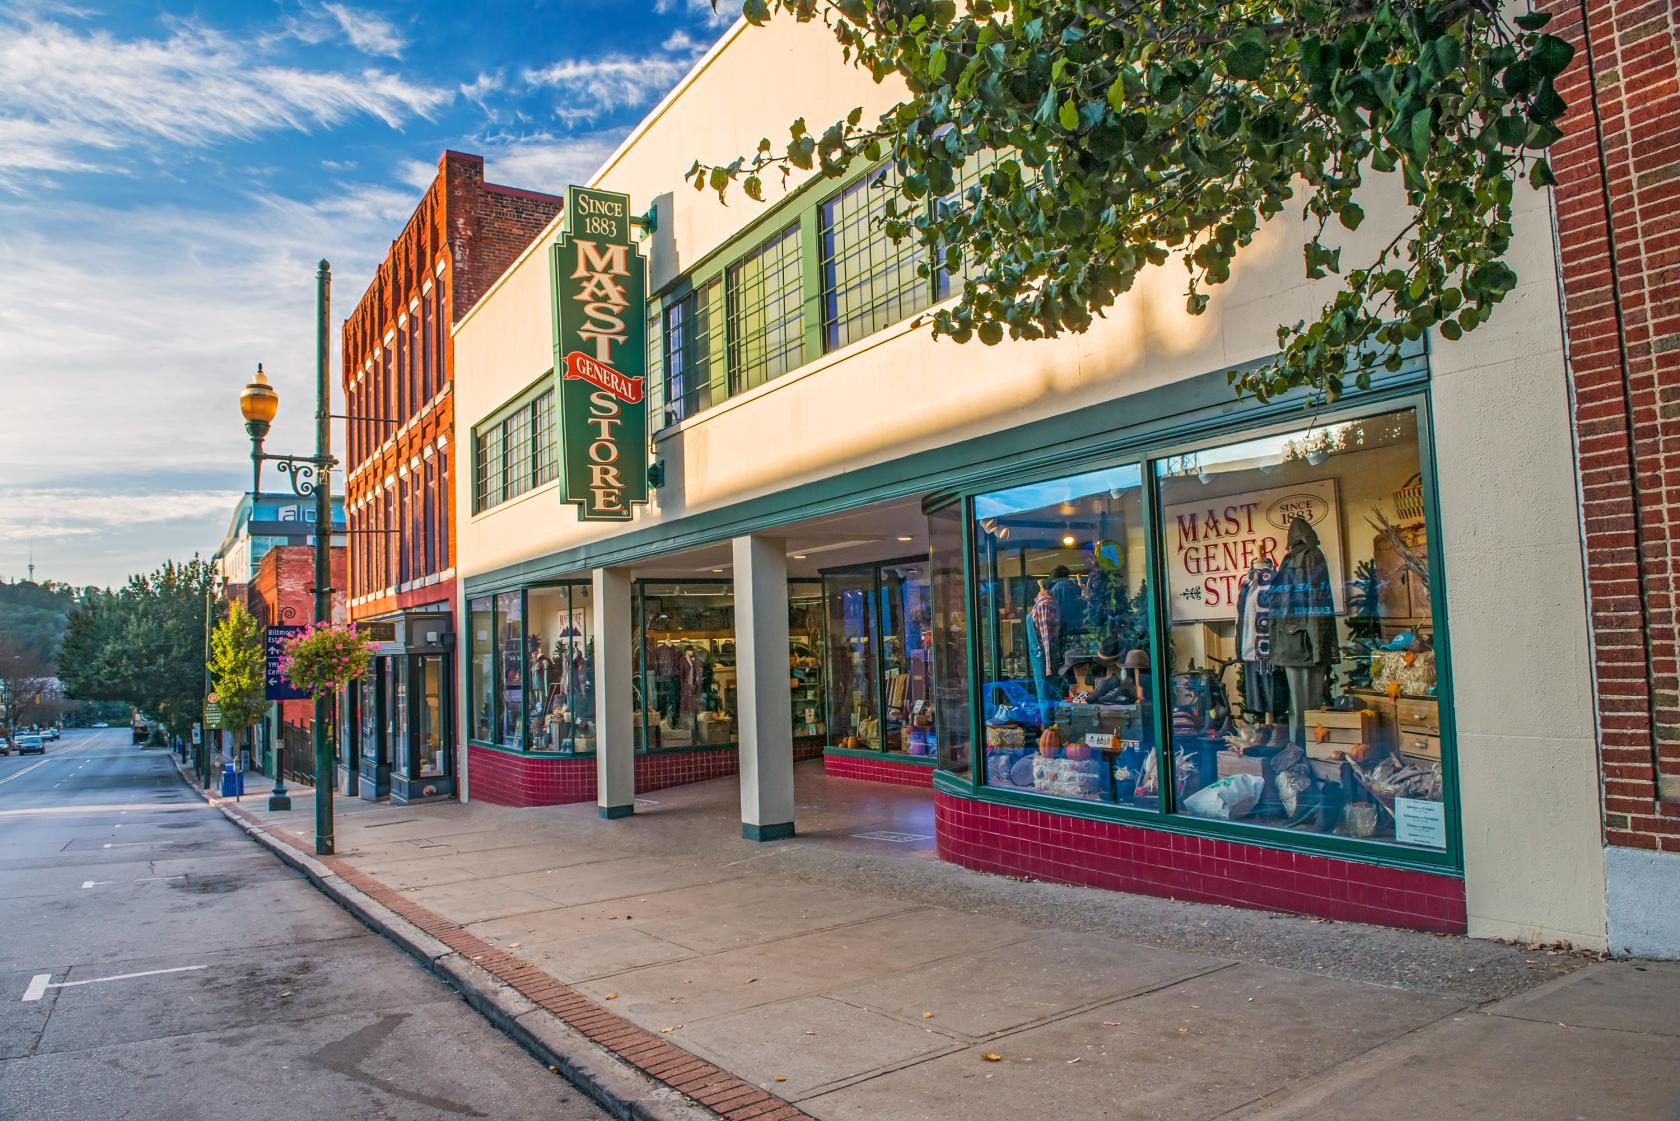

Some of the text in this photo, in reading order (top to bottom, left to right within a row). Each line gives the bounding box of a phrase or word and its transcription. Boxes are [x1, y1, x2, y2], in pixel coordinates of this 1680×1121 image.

[578, 194, 622, 217] SINCE
[585, 216, 616, 237] 1883
[570, 238, 631, 364] MAST
[576, 356, 636, 400] GENERAL
[587, 391, 624, 511] STORE
[1280, 500, 1312, 511] SINCE
[1281, 510, 1313, 524] 1883
[1176, 502, 1258, 552] MAST
